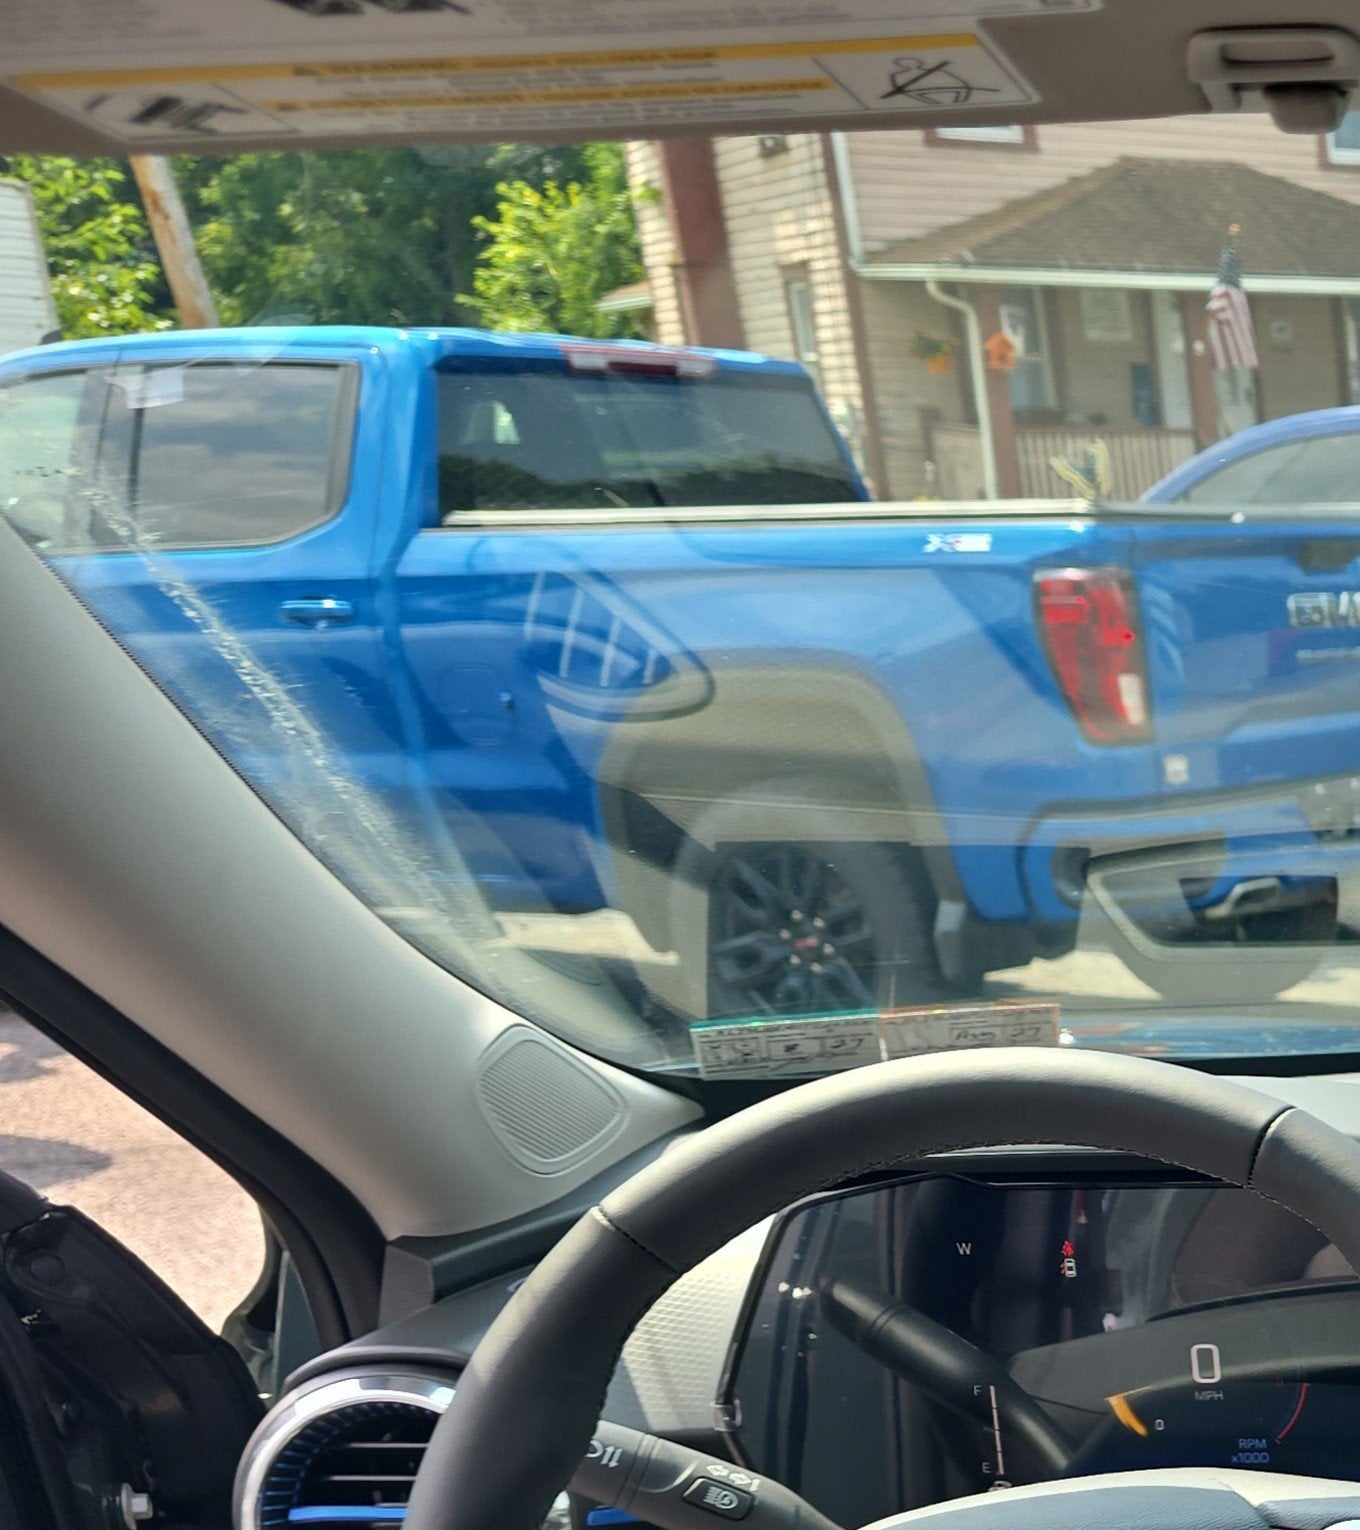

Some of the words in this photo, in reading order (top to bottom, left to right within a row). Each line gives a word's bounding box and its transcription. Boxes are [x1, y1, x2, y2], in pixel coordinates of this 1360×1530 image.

[955, 1242, 972, 1256] W
[1190, 1343, 1221, 1384] 0
[973, 1384, 982, 1396] F
[1194, 1390, 1224, 1401] MPH
[1238, 1437, 1268, 1449] RPM
[1231, 1452, 1270, 1464] x1000
[981, 1462, 992, 1474] E
